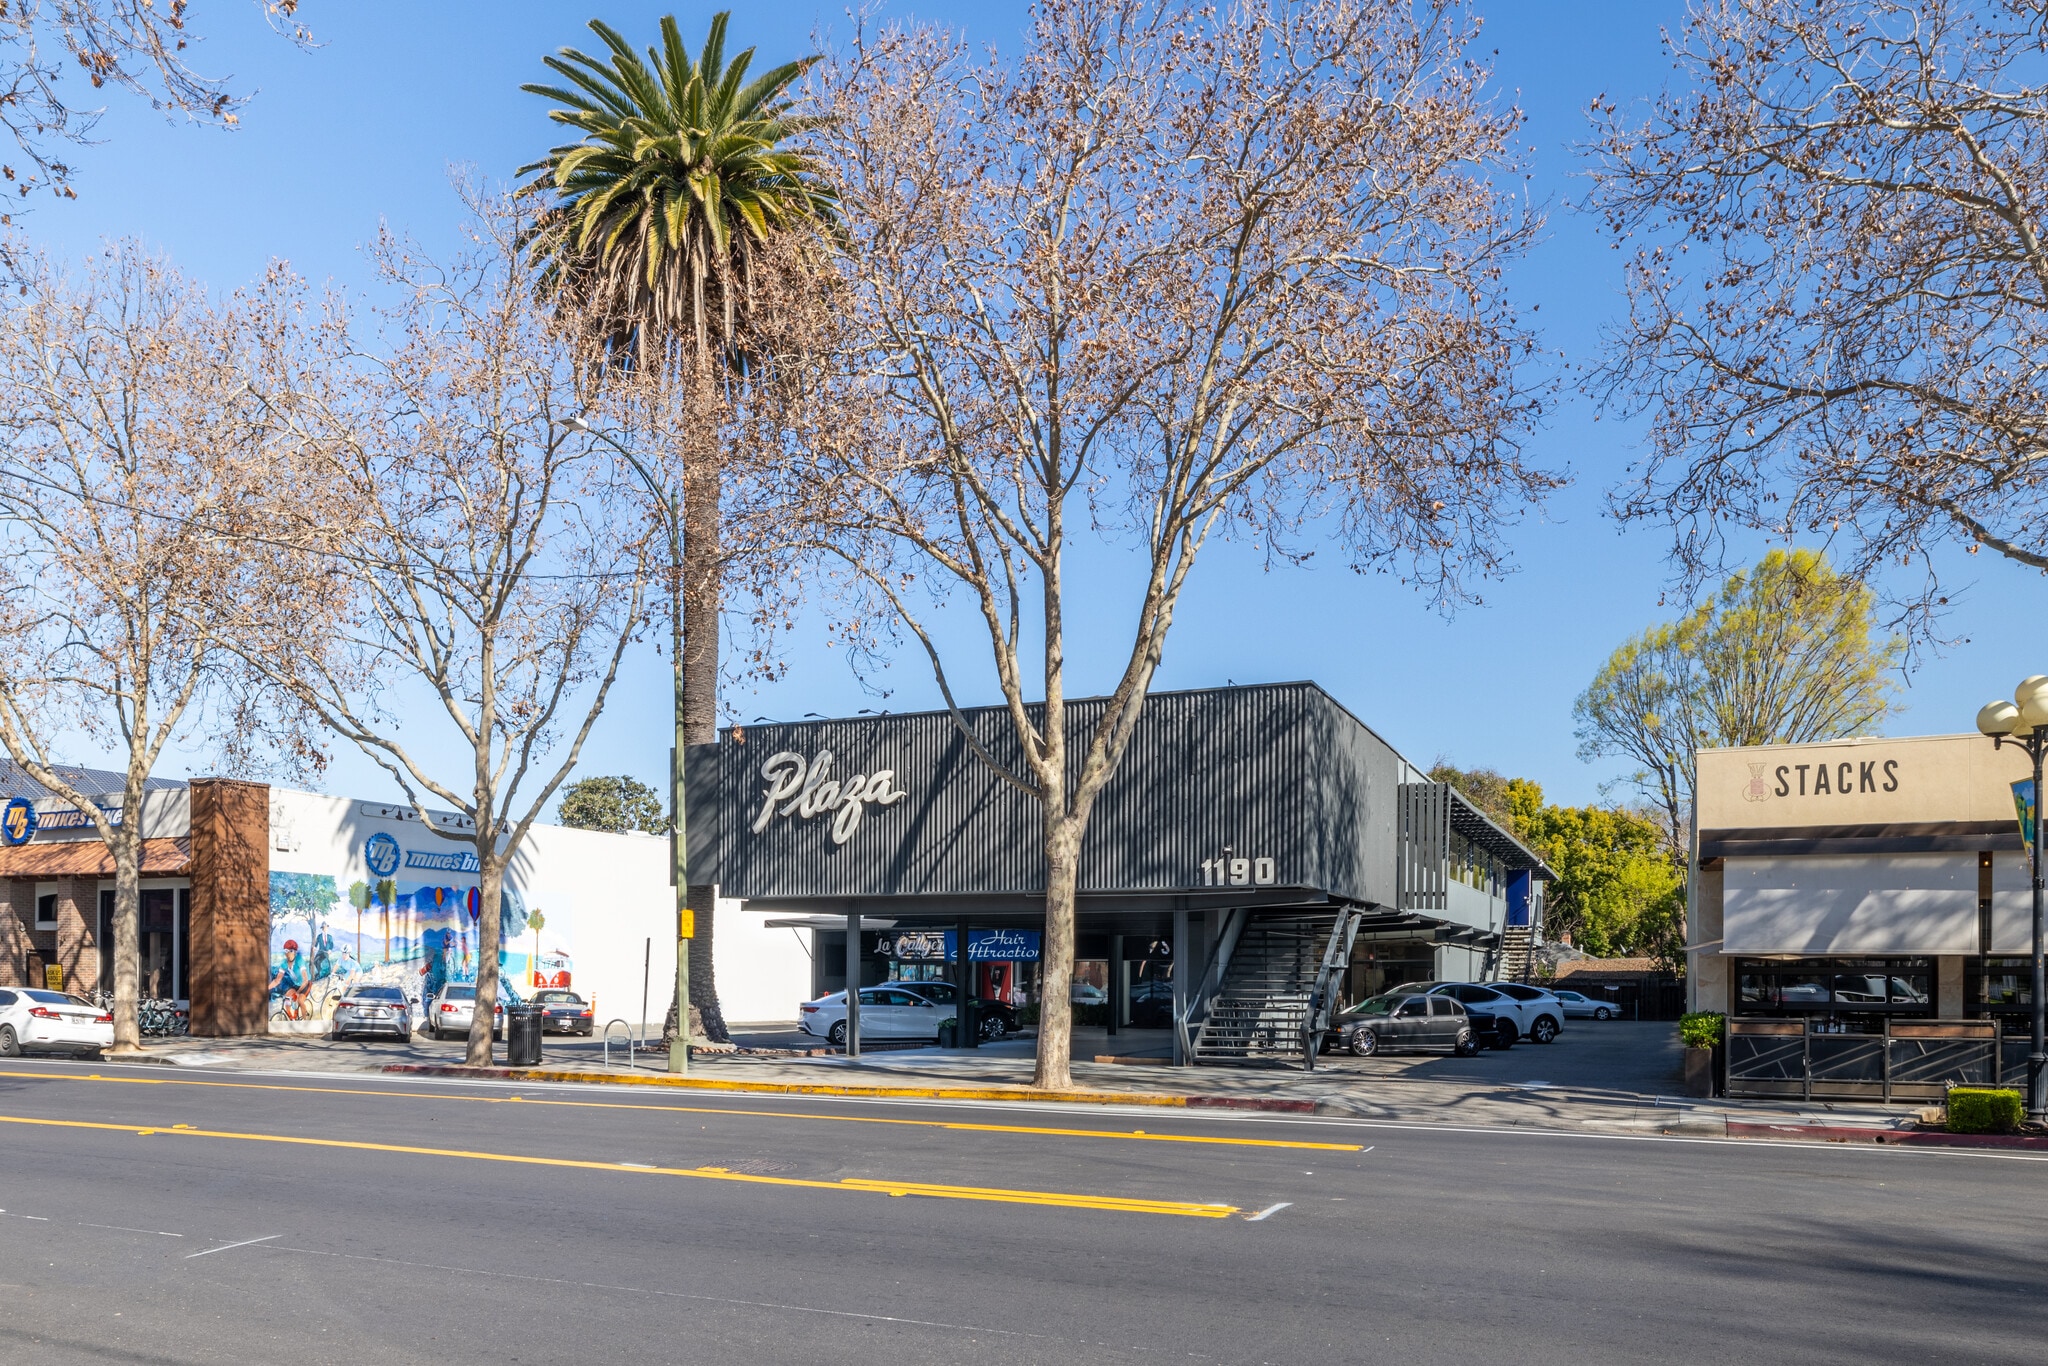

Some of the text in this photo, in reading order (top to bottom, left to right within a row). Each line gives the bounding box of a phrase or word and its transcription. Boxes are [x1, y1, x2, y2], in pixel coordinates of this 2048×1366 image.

[1774, 759, 1899, 797] STACKS
[752, 749, 907, 844] Plaza
[1201, 857, 1275, 886] 1190
[873, 937, 891, 955] La
[980, 930, 1025, 945] Hair
